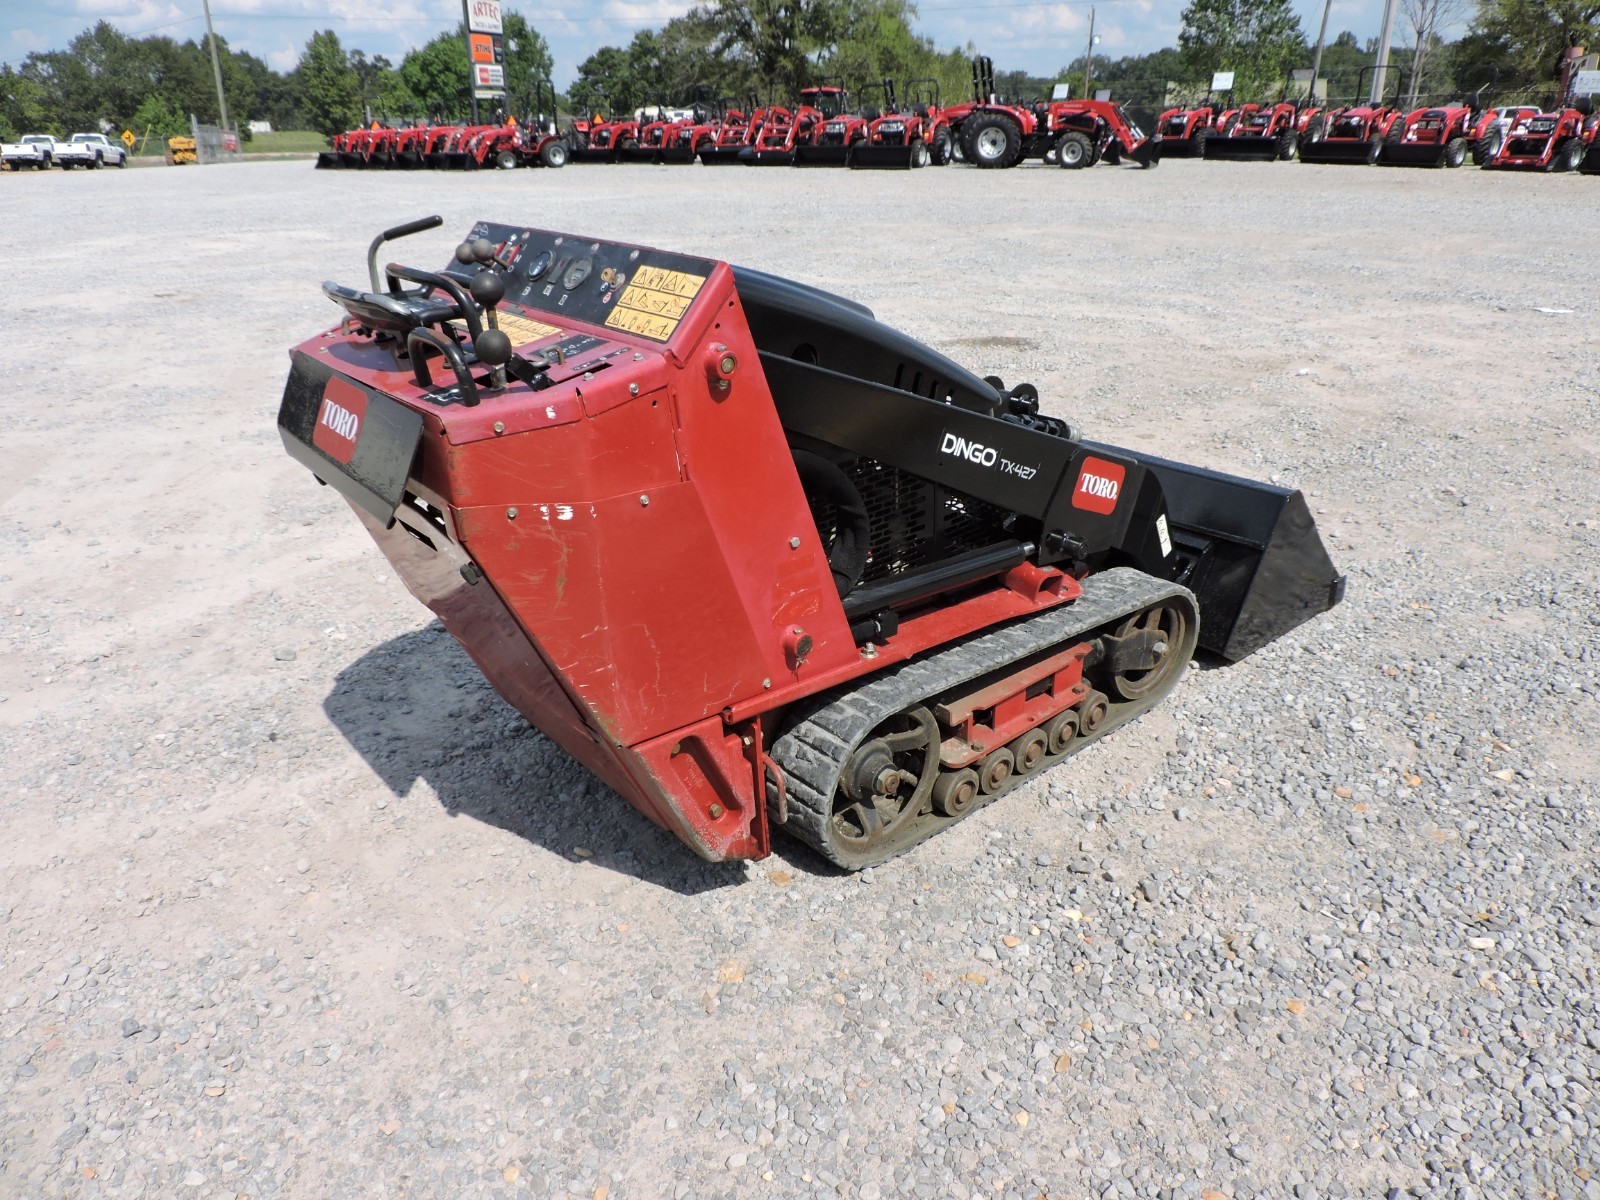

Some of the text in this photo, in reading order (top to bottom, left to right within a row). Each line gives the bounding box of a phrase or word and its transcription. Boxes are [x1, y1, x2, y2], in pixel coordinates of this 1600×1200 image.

[473, 1, 500, 22] ARTEC
[475, 44, 492, 53] STIHL
[321, 399, 358, 440] TORO
[941, 433, 997, 467] DINGO
[1080, 473, 1118, 499] TORO
